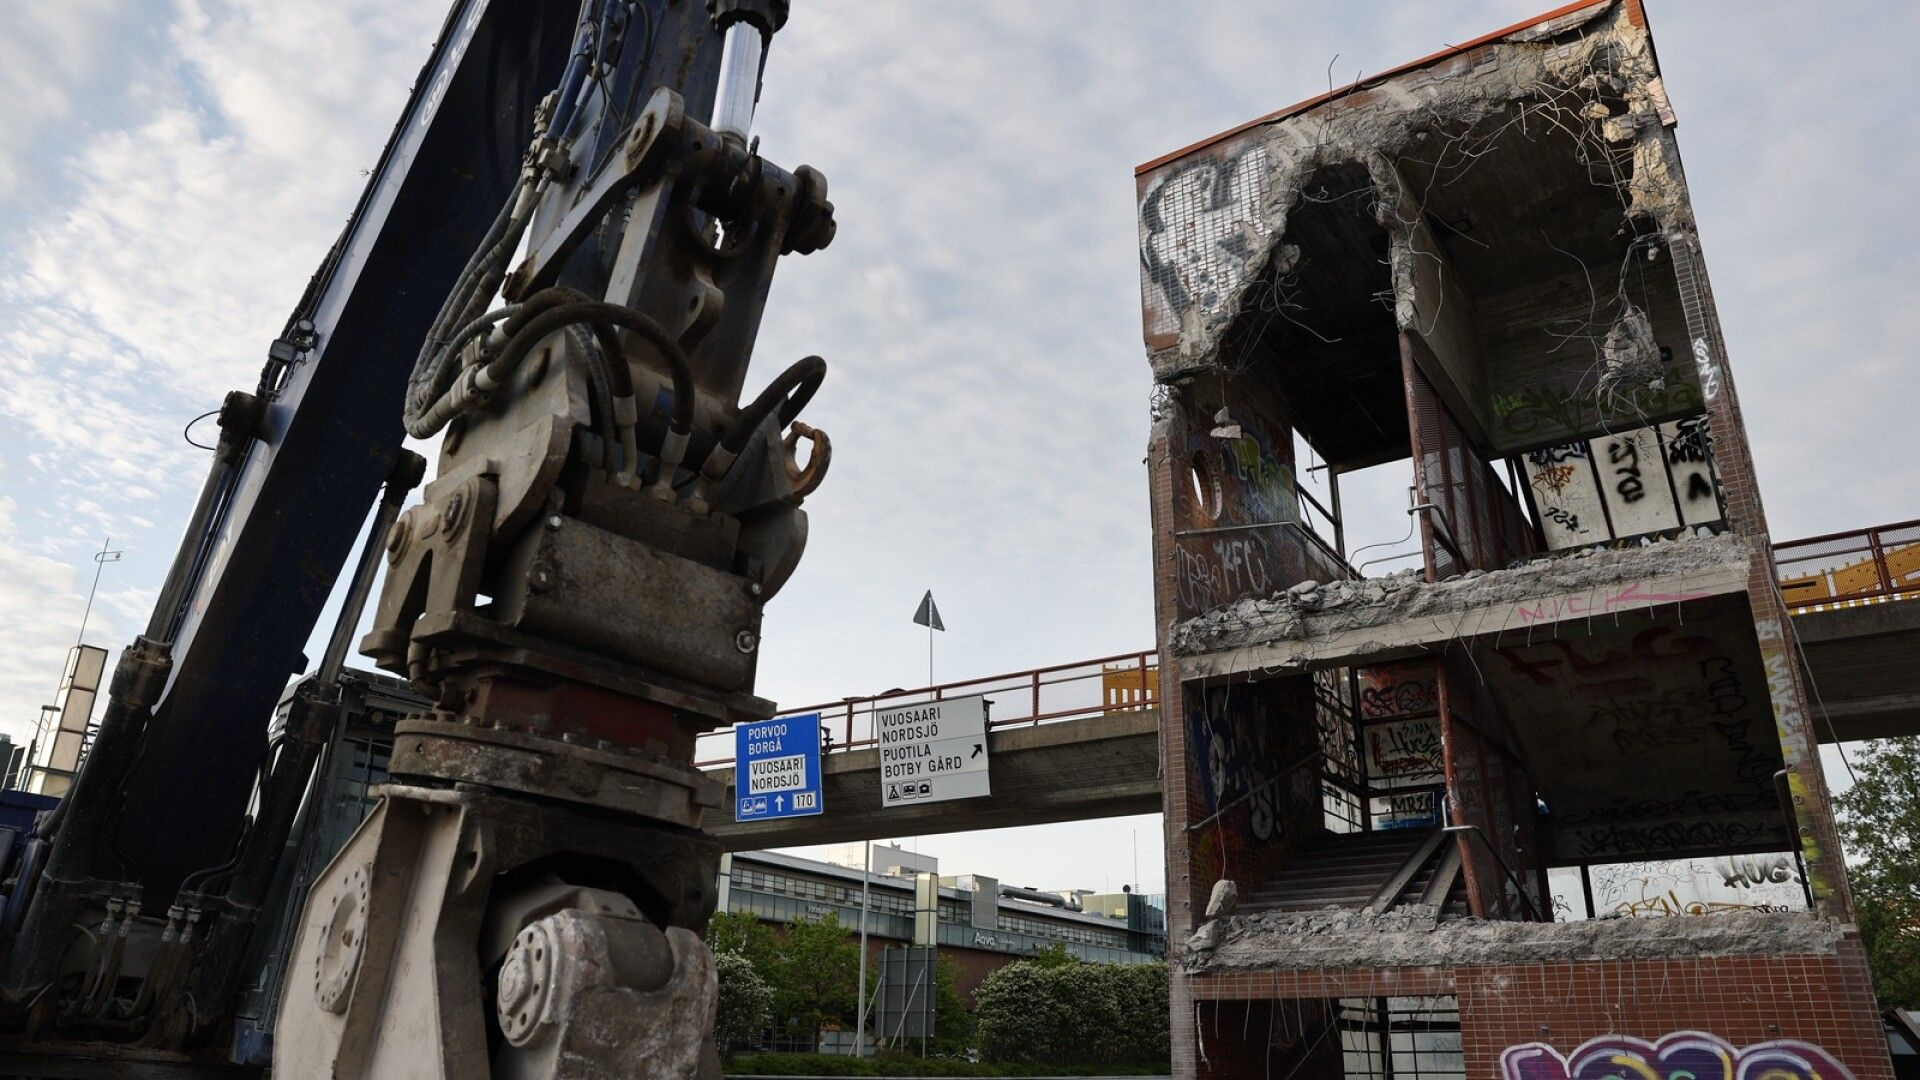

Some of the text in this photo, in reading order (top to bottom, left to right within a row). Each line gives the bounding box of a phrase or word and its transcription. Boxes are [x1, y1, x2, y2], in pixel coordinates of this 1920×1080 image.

[881, 707, 941, 727] VUOSAARI
[748, 724, 787, 740] PORVOO
[882, 724, 938, 743] NORDSJÖ
[748, 738, 782, 755] BORGÅ
[883, 744, 931, 761] PUOTILA
[751, 757, 804, 775] VUOSAARI
[885, 756, 962, 778] BOTBY GÅRD
[751, 771, 800, 790] NORDSJÖ
[796, 795, 812, 807] 170
